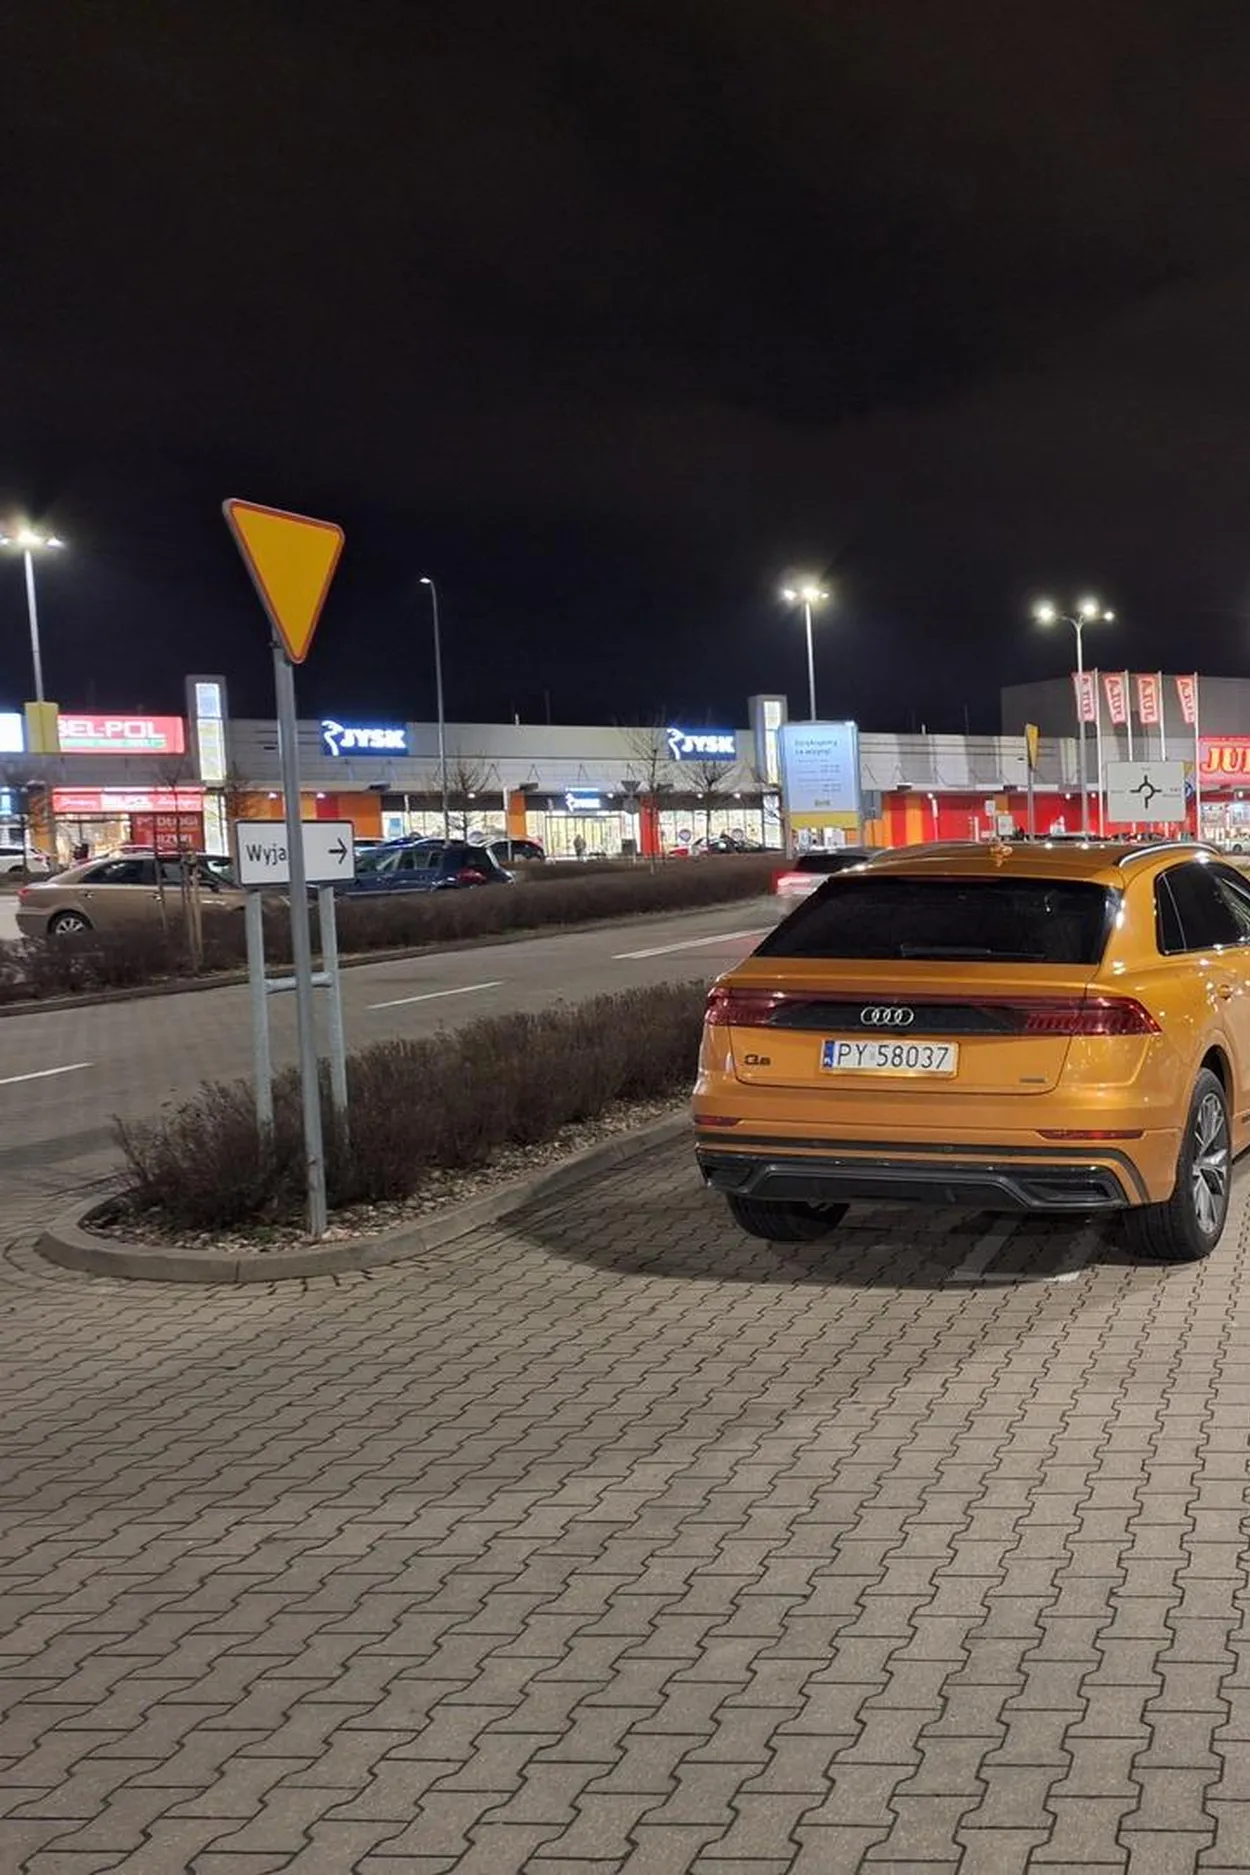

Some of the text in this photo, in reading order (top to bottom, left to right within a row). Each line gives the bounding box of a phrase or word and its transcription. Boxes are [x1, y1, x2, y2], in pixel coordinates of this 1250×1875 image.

[340, 728, 406, 748] JYSK
[680, 735, 735, 753] JYSK
[246, 843, 290, 866] Wyja
[837, 1043, 950, 1070] PY 58037
